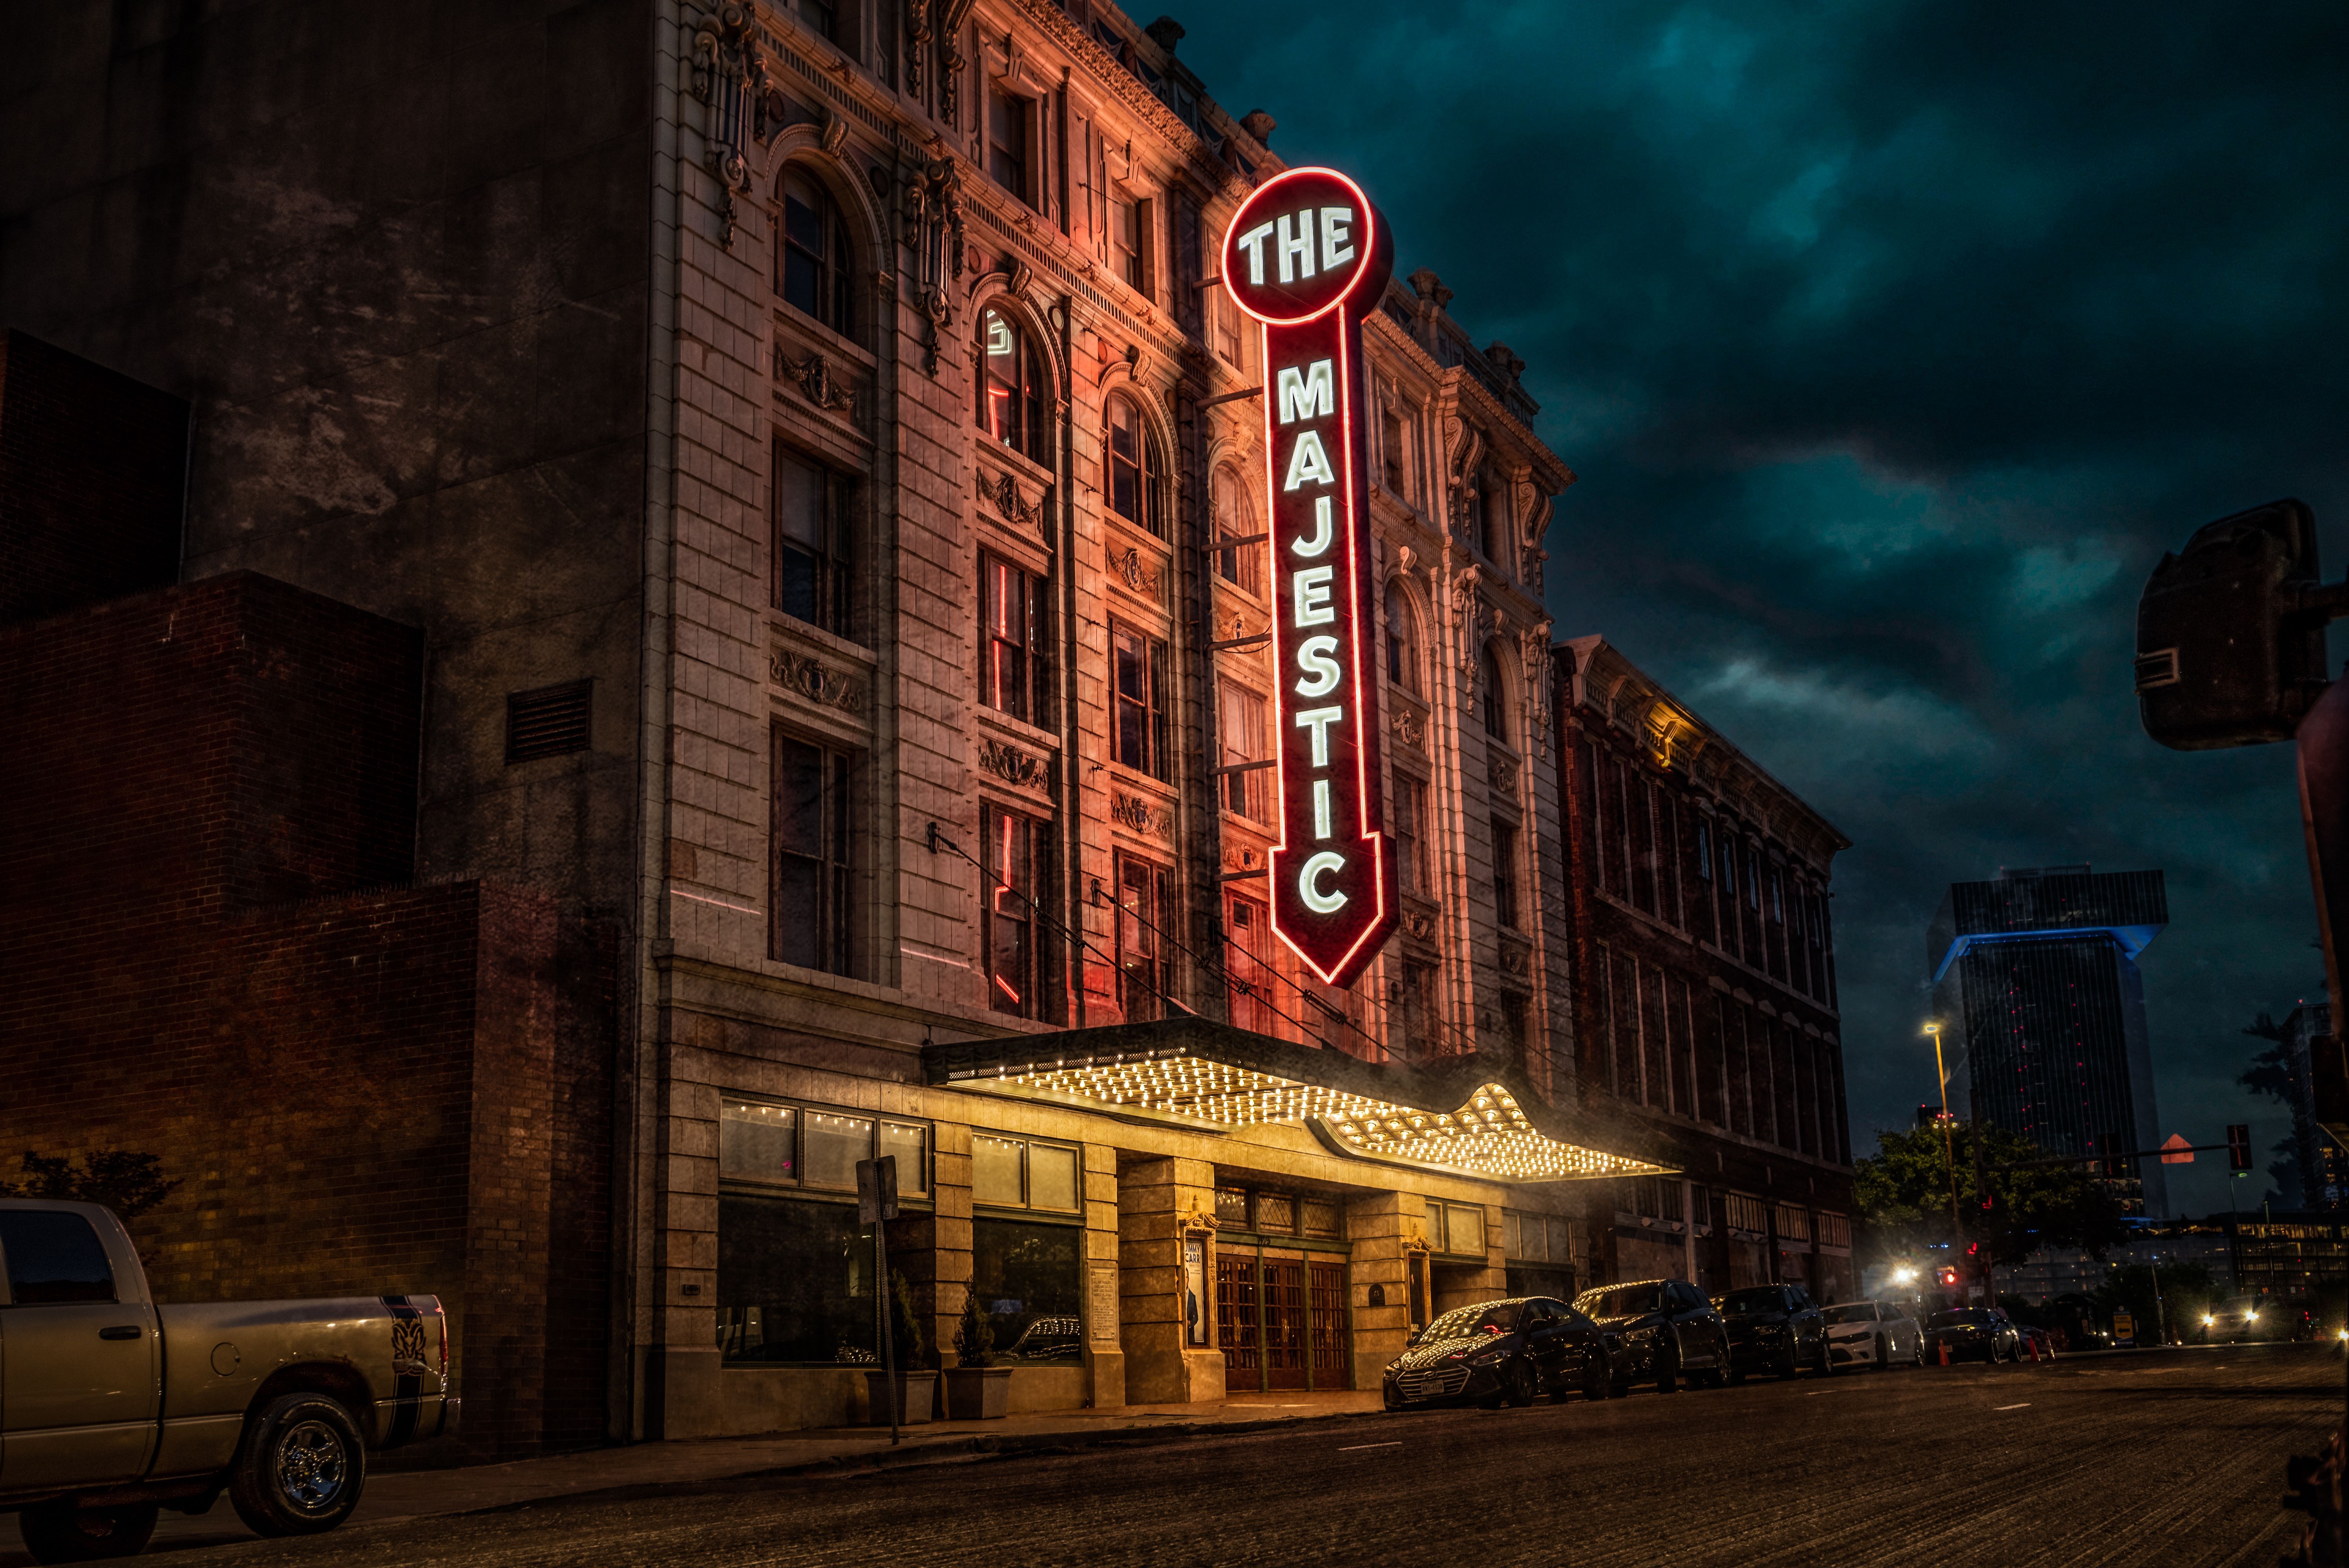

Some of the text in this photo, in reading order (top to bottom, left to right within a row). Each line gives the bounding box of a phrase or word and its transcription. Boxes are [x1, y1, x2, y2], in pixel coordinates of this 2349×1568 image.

[1238, 207, 1354, 285] THE
[1277, 358, 1348, 914] MAJESTIC
[1185, 1244, 1200, 1253] JIMMY
[1185, 1253, 1200, 1263] CARR
